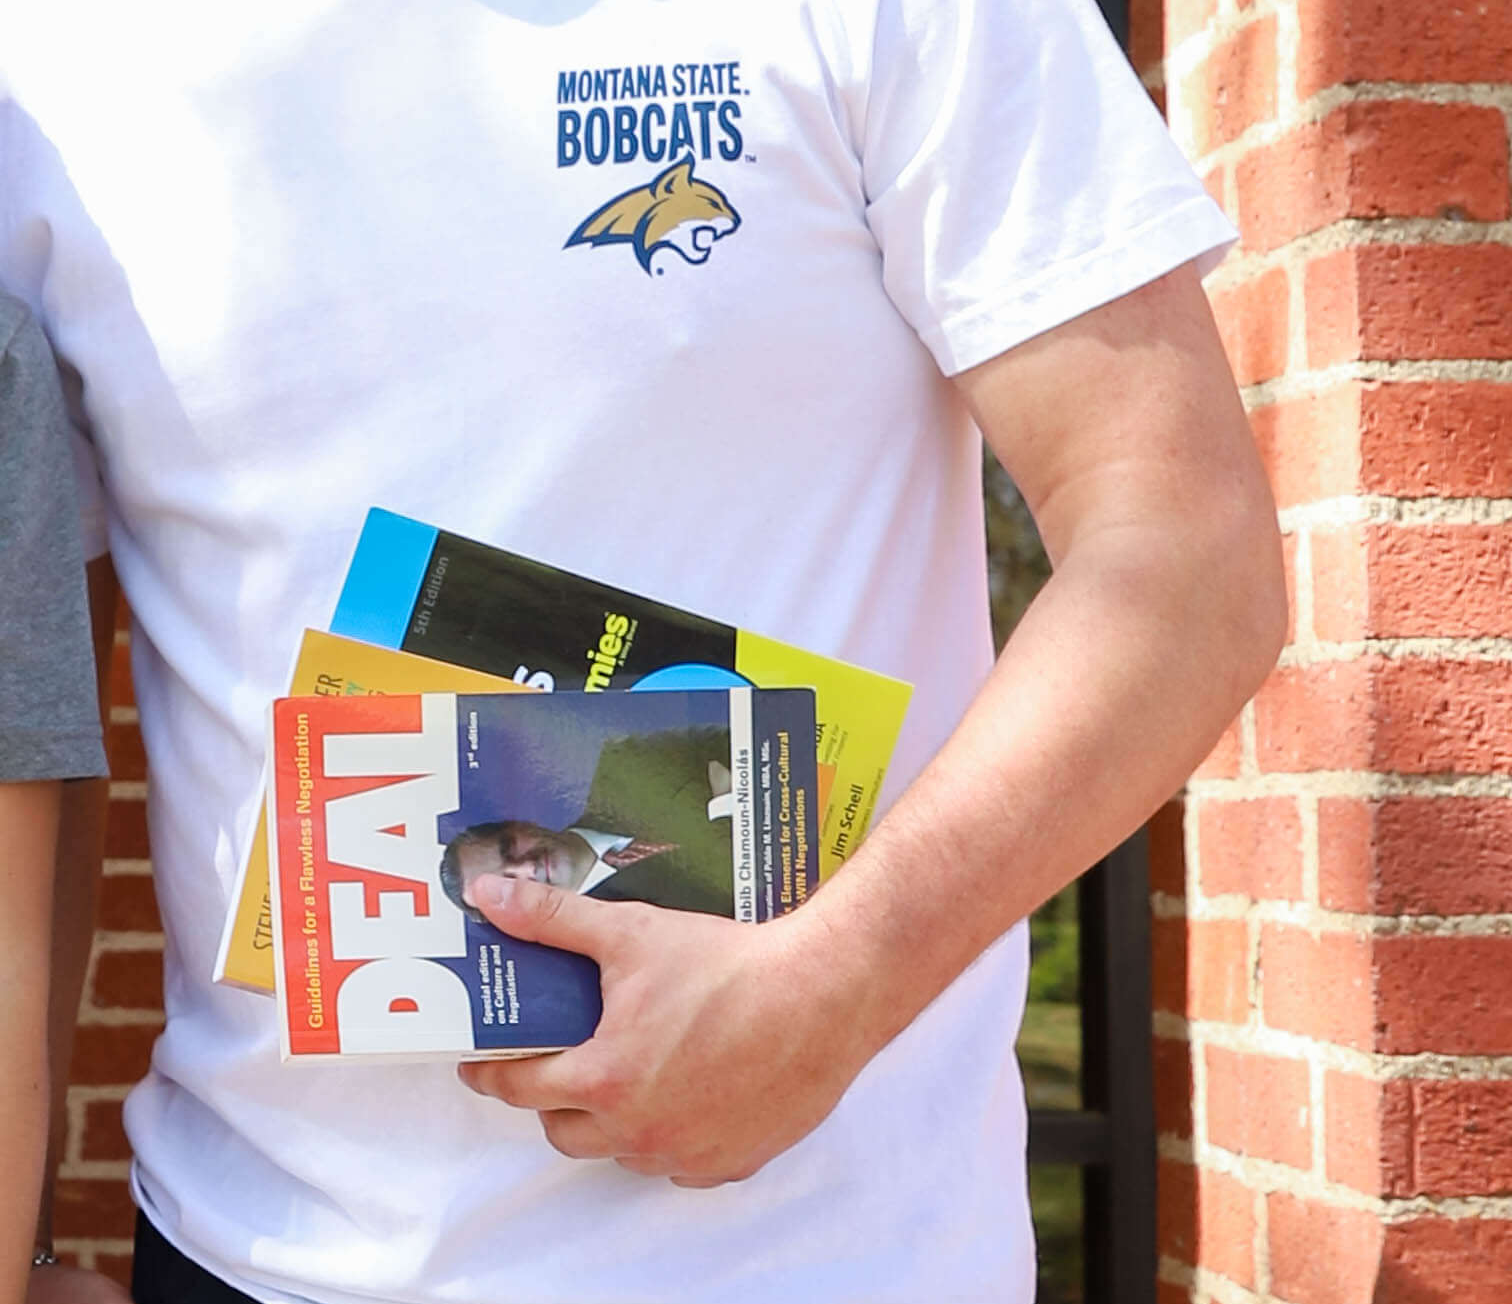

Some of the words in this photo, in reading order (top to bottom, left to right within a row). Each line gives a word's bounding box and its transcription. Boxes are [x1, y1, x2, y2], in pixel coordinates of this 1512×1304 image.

[557, 64, 668, 104] MONTANA
[557, 100, 743, 168] BOBCATS
[414, 610, 431, 636] 5th
[423, 556, 449, 608] Edition
[584, 612, 629, 693] mies
[468, 711, 478, 750] edition
[294, 713, 314, 814] Negotiation
[778, 732, 790, 823] Cross-Cultural
[737, 748, 751, 881] Chamoun-Nicolás
[780, 826, 791, 843] for
[796, 789, 809, 869] Negotiations
[831, 833, 848, 861] Jim
[840, 784, 864, 829] Schell
[298, 817, 316, 892] Flawless
[323, 692, 475, 1054] DEAL
[781, 846, 792, 903] Elements
[302, 909, 318, 935] for
[304, 895, 316, 907] a
[303, 938, 324, 1028] Guidelines
[478, 945, 490, 984] edition
[490, 944, 502, 966] and
[480, 985, 493, 1025] Special
[493, 968, 505, 1008] Culture
[496, 1010, 507, 1025] on
[506, 960, 520, 1024] Negotiation
